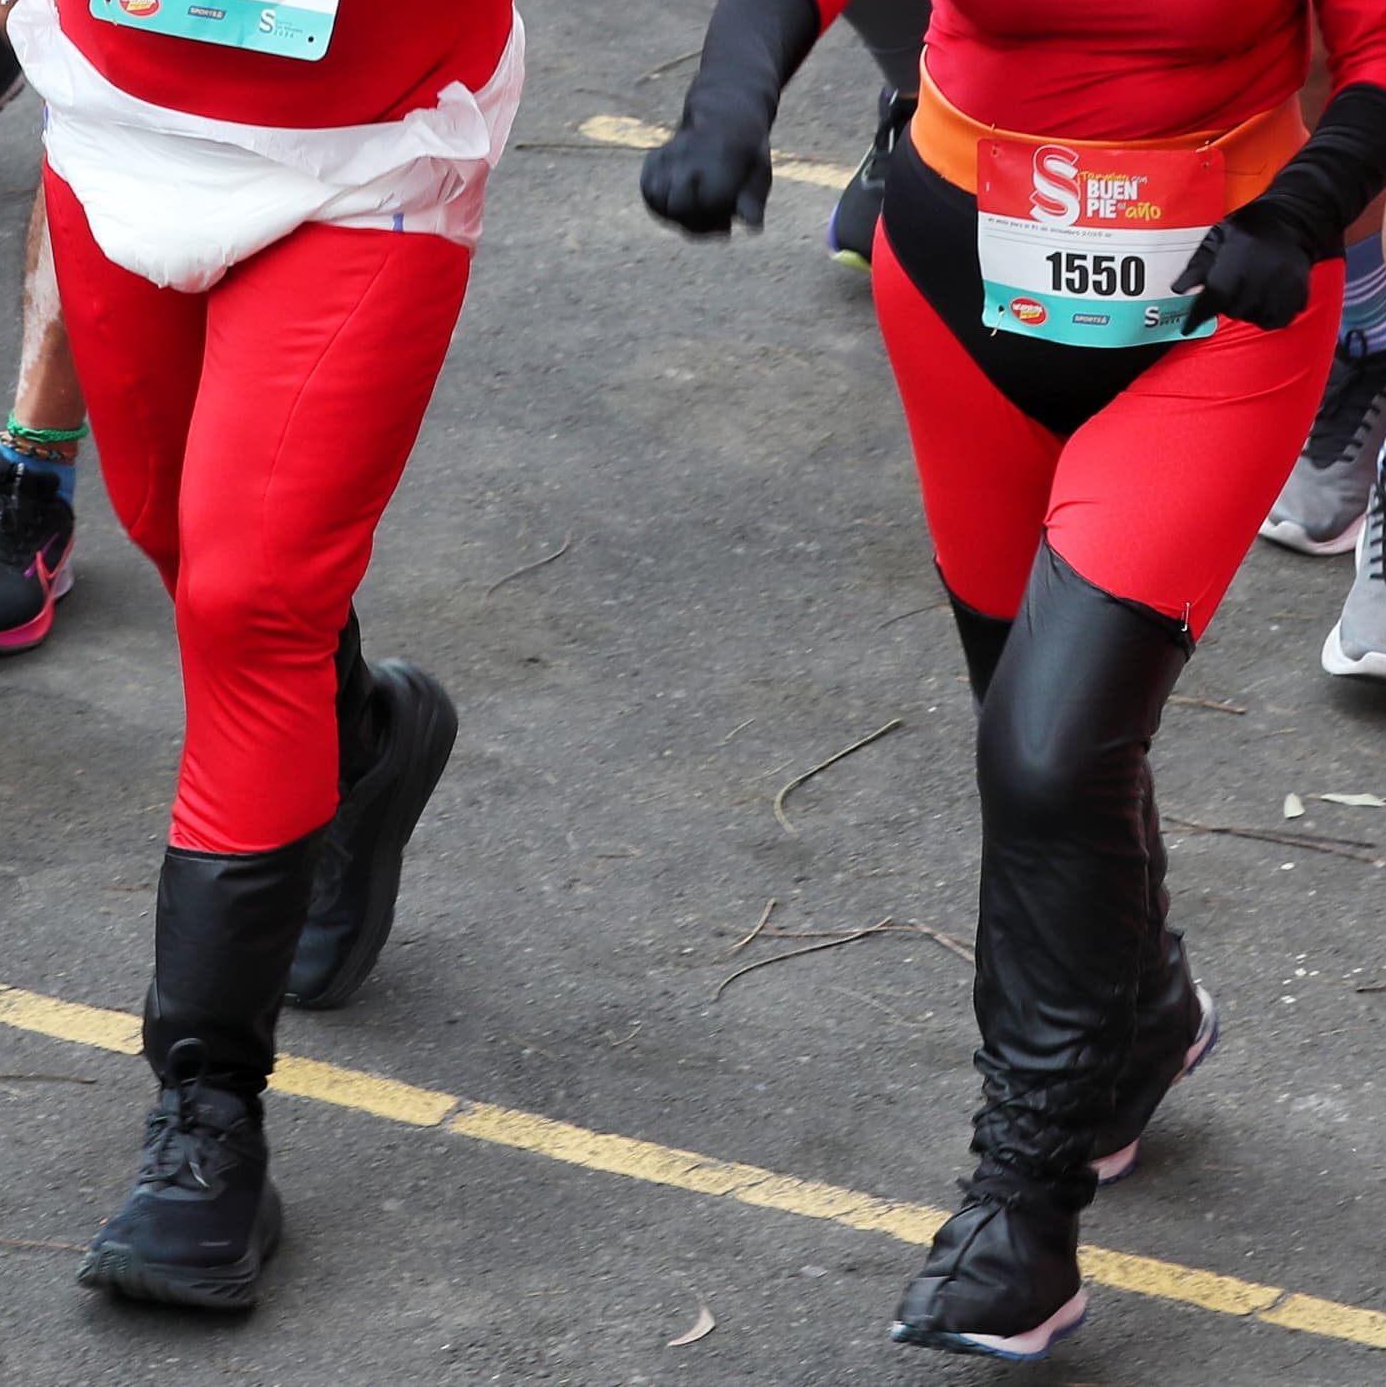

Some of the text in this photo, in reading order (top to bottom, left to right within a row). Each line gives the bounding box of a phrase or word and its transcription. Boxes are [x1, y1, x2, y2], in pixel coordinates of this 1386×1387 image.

[1086, 179, 1139, 201] BUEN
[1086, 199, 1162, 222] PIE año
[1045, 251, 1146, 297] 1550
